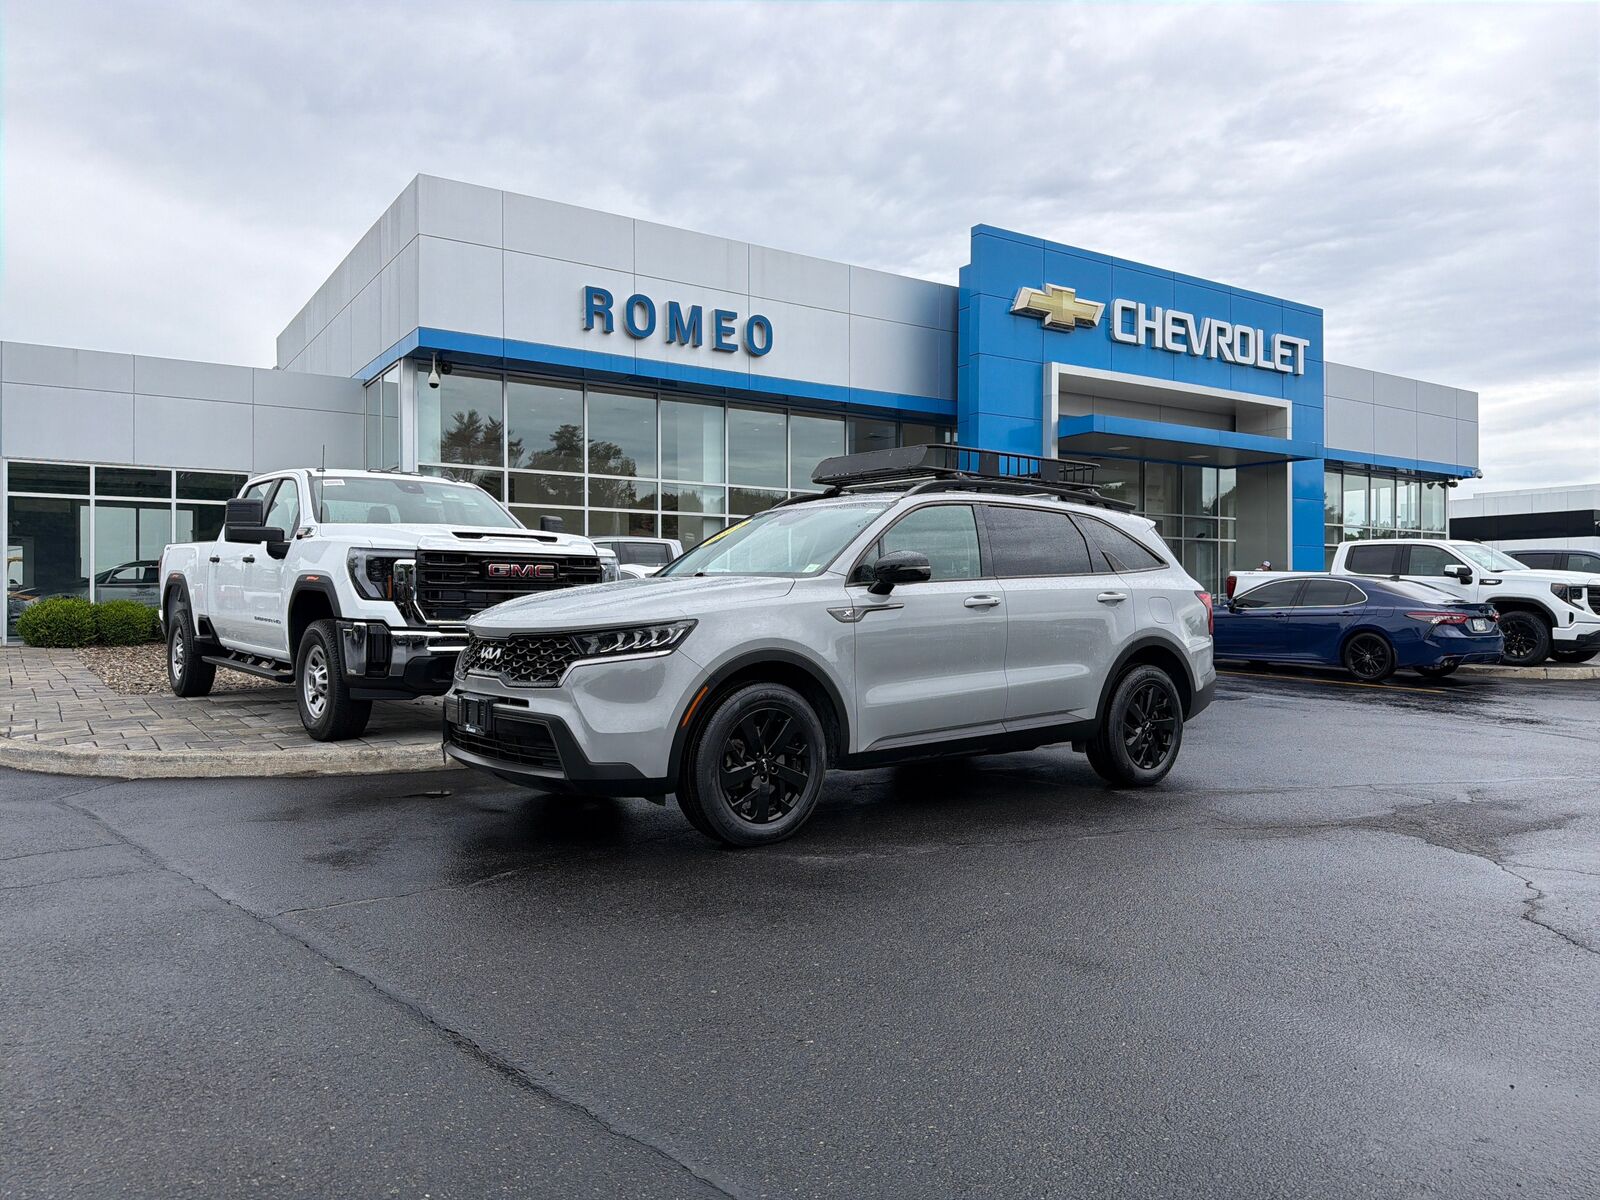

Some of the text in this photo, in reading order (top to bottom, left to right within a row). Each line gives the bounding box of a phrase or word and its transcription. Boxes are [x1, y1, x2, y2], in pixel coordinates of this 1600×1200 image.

[583, 285, 773, 357] ROMEO
[1110, 298, 1310, 375] CHEVROLET
[488, 563, 555, 577] GMC
